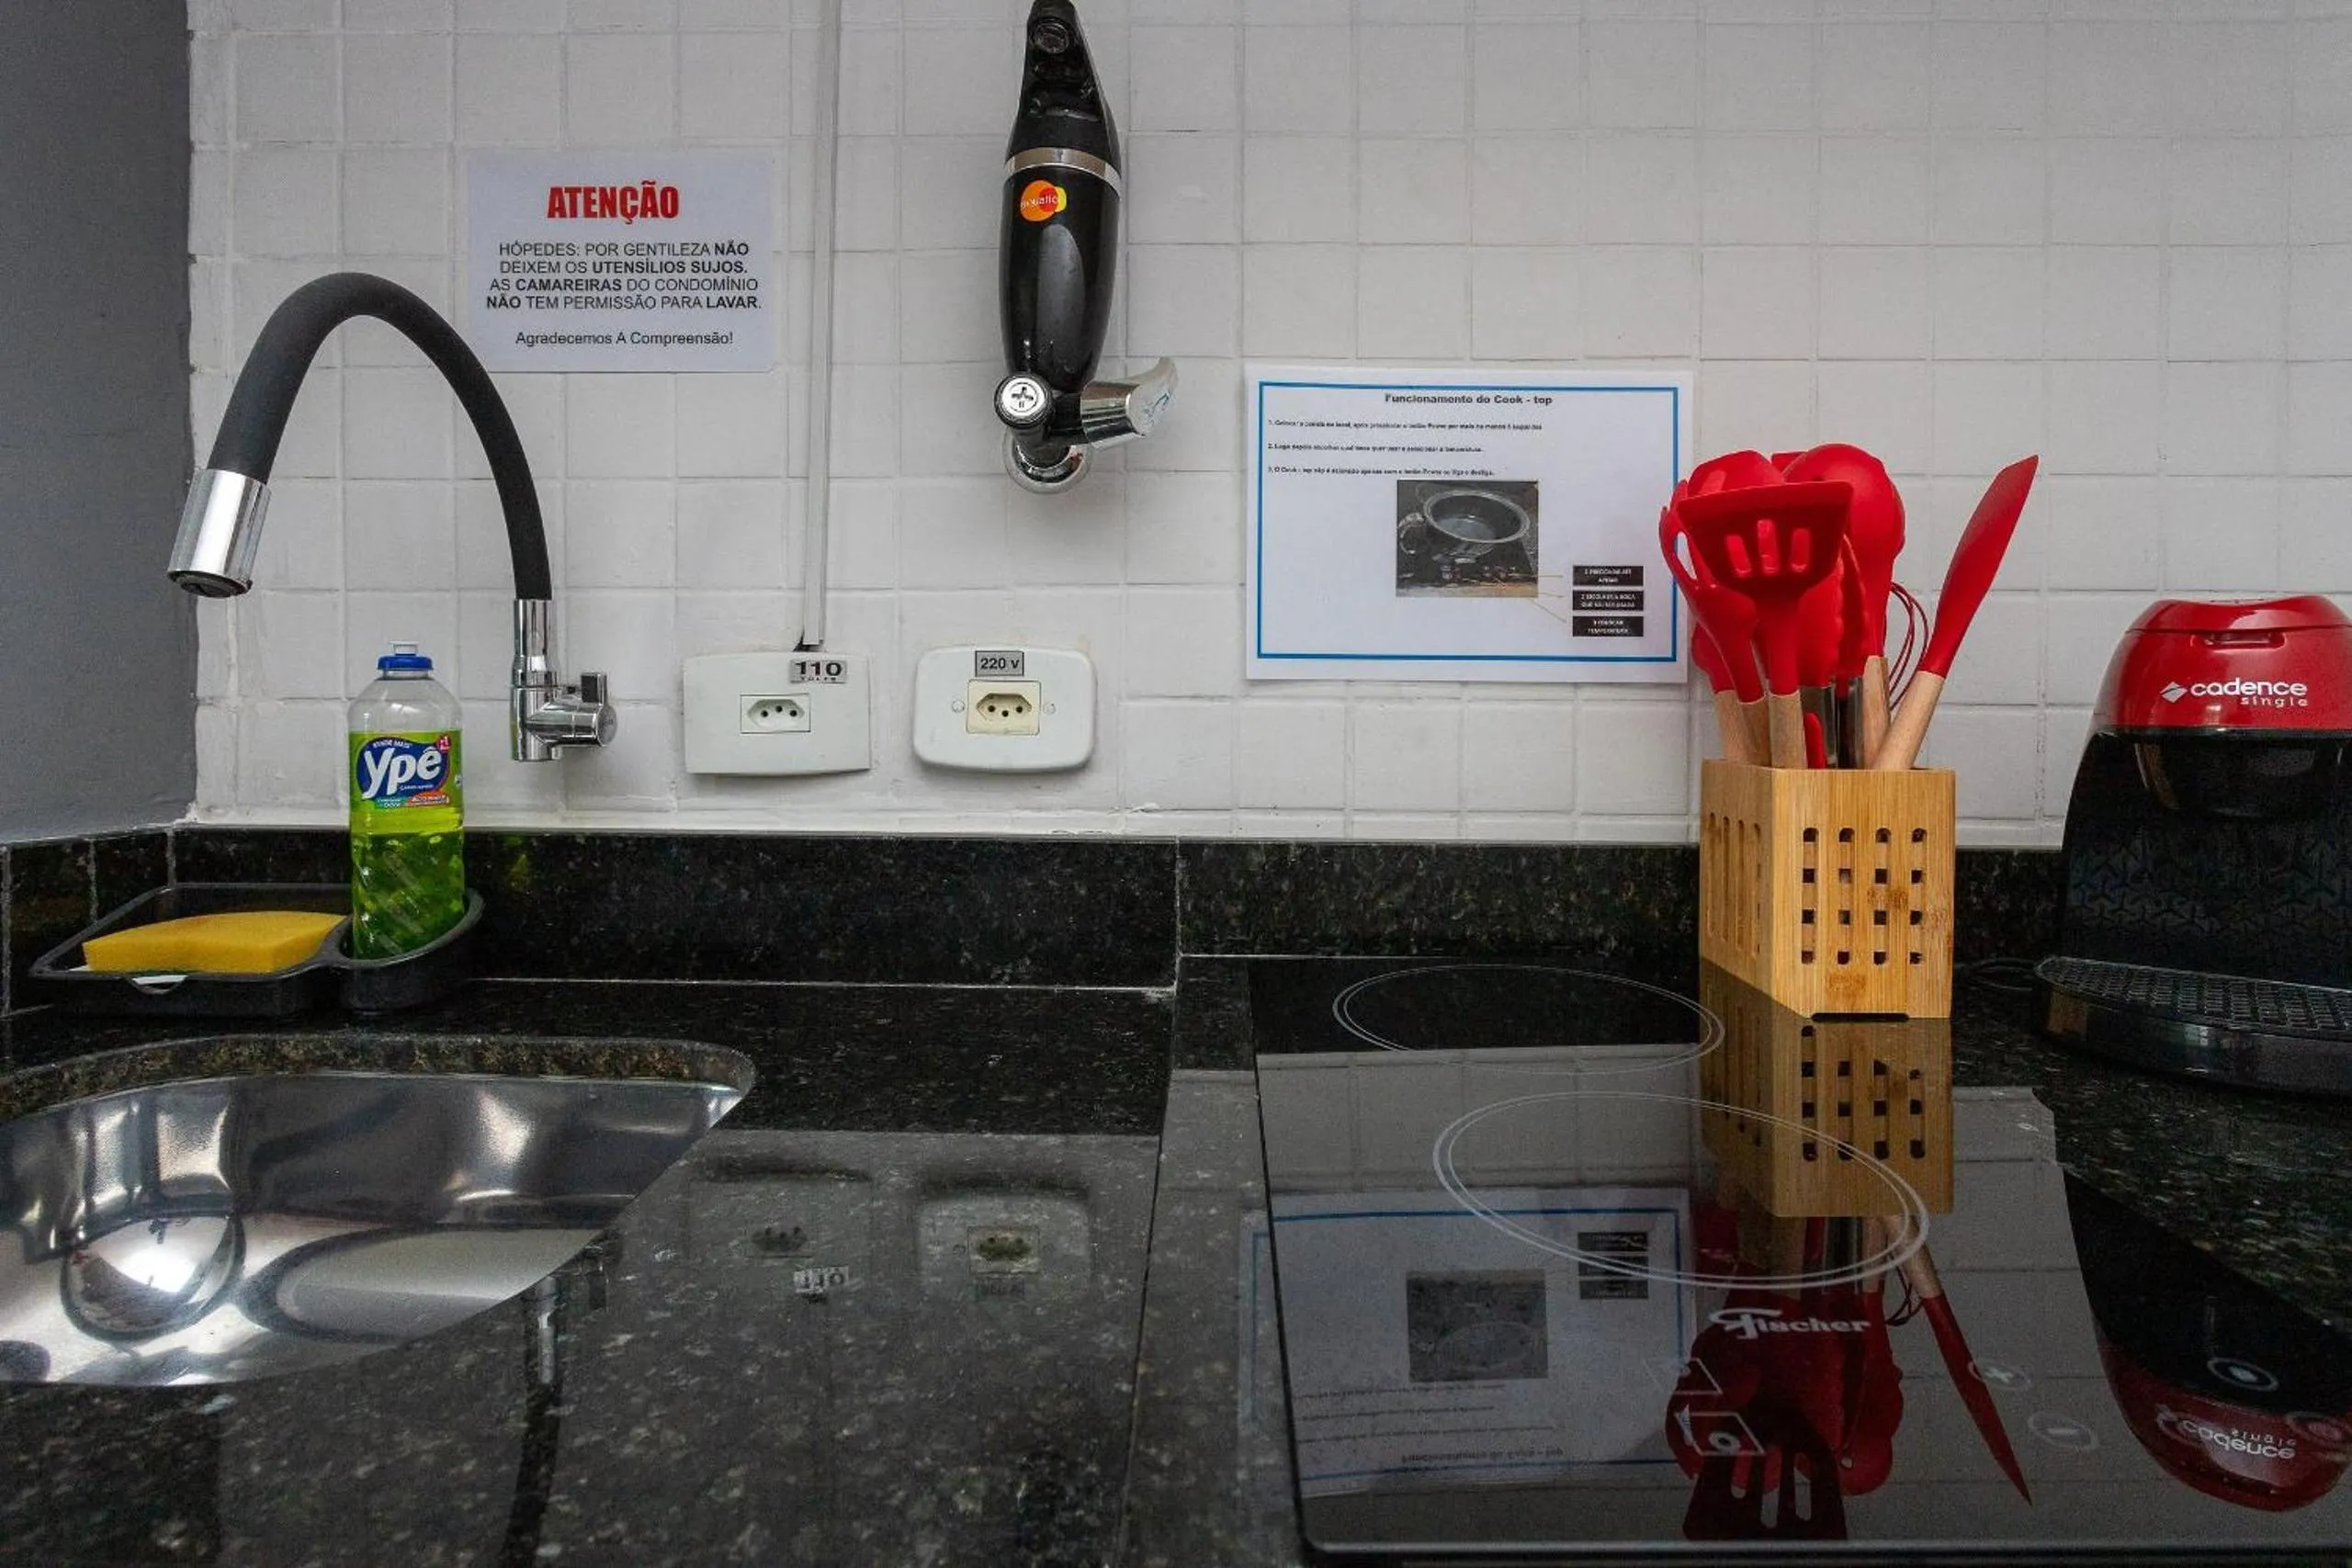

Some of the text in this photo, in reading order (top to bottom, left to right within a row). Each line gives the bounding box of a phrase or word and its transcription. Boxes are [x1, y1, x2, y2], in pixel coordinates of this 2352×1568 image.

[547, 180, 679, 224] ATENÇÃO
[499, 240, 749, 256] HÓPEDES: POR GENTILEZA NÃO
[500, 258, 748, 274] DEIXEM OS UTENSÍLIOS SUJOS.
[490, 276, 758, 291] AS CAMAREIRAS DO CONDOMÍNIO
[486, 293, 762, 309] NÃO TEM PERMISSÃO PARA LAVAR.
[515, 332, 733, 347] Agradecemos A Compreensão!
[1385, 394, 1473, 404] Funcionamento
[1476, 395, 1490, 404] do
[1494, 395, 1523, 404] Cook
[1534, 396, 1553, 406] top
[796, 661, 842, 676] 110
[980, 658, 1006, 670] 220
[2191, 678, 2308, 696] cadence
[2240, 696, 2308, 708] single
[361, 746, 442, 799] Ypê
